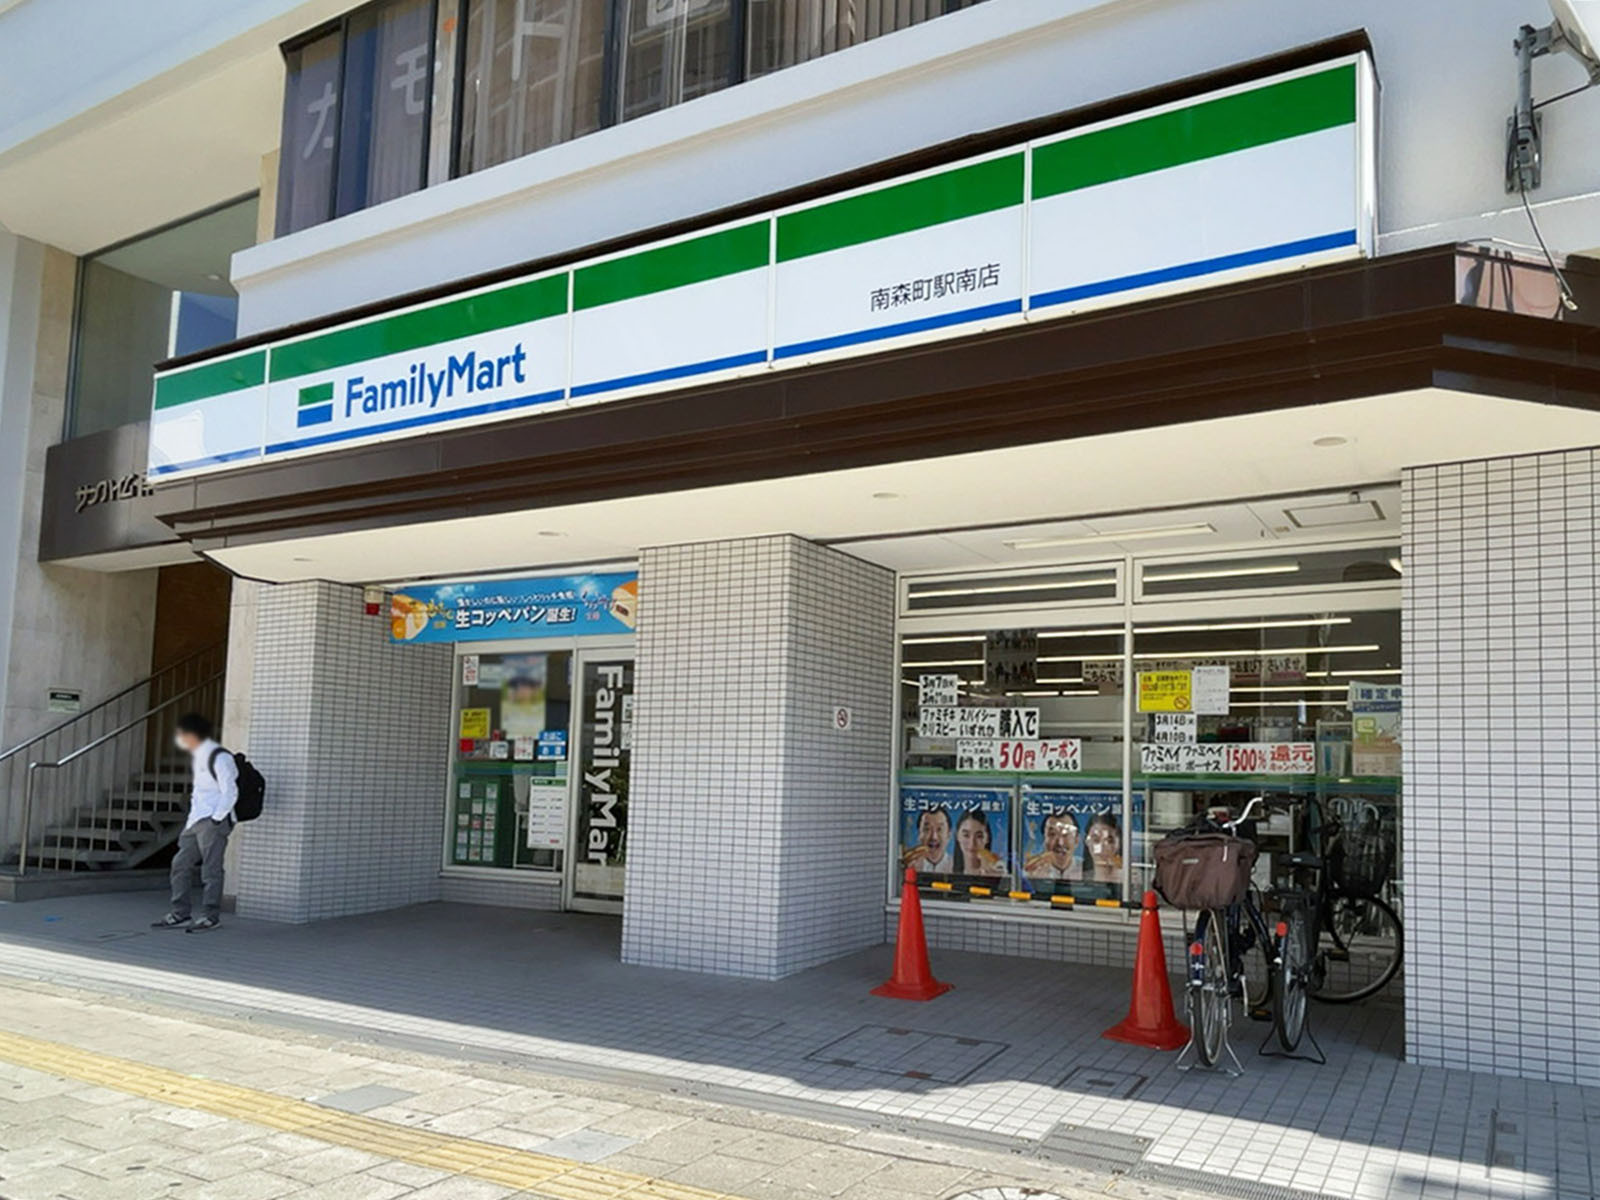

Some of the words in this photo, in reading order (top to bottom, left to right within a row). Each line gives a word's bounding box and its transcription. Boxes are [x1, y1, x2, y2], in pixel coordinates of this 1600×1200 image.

[870, 263, 1000, 312] 南森町駅南店
[345, 343, 526, 417] FamilyMart
[922, 709, 956, 722] ファミチキ
[959, 709, 997, 722] スパイシー
[960, 724, 995, 737] いずれか
[1040, 741, 1078, 759] クーポン
[1142, 746, 1182, 762] ファミペイ
[1183, 746, 1224, 757] ファミペイ
[1226, 748, 1267, 771] 1500%
[1270, 745, 1313, 762] 還元
[1186, 760, 1222, 770] ボーナス
[904, 799, 1005, 812] 生コッペパン誕生!
